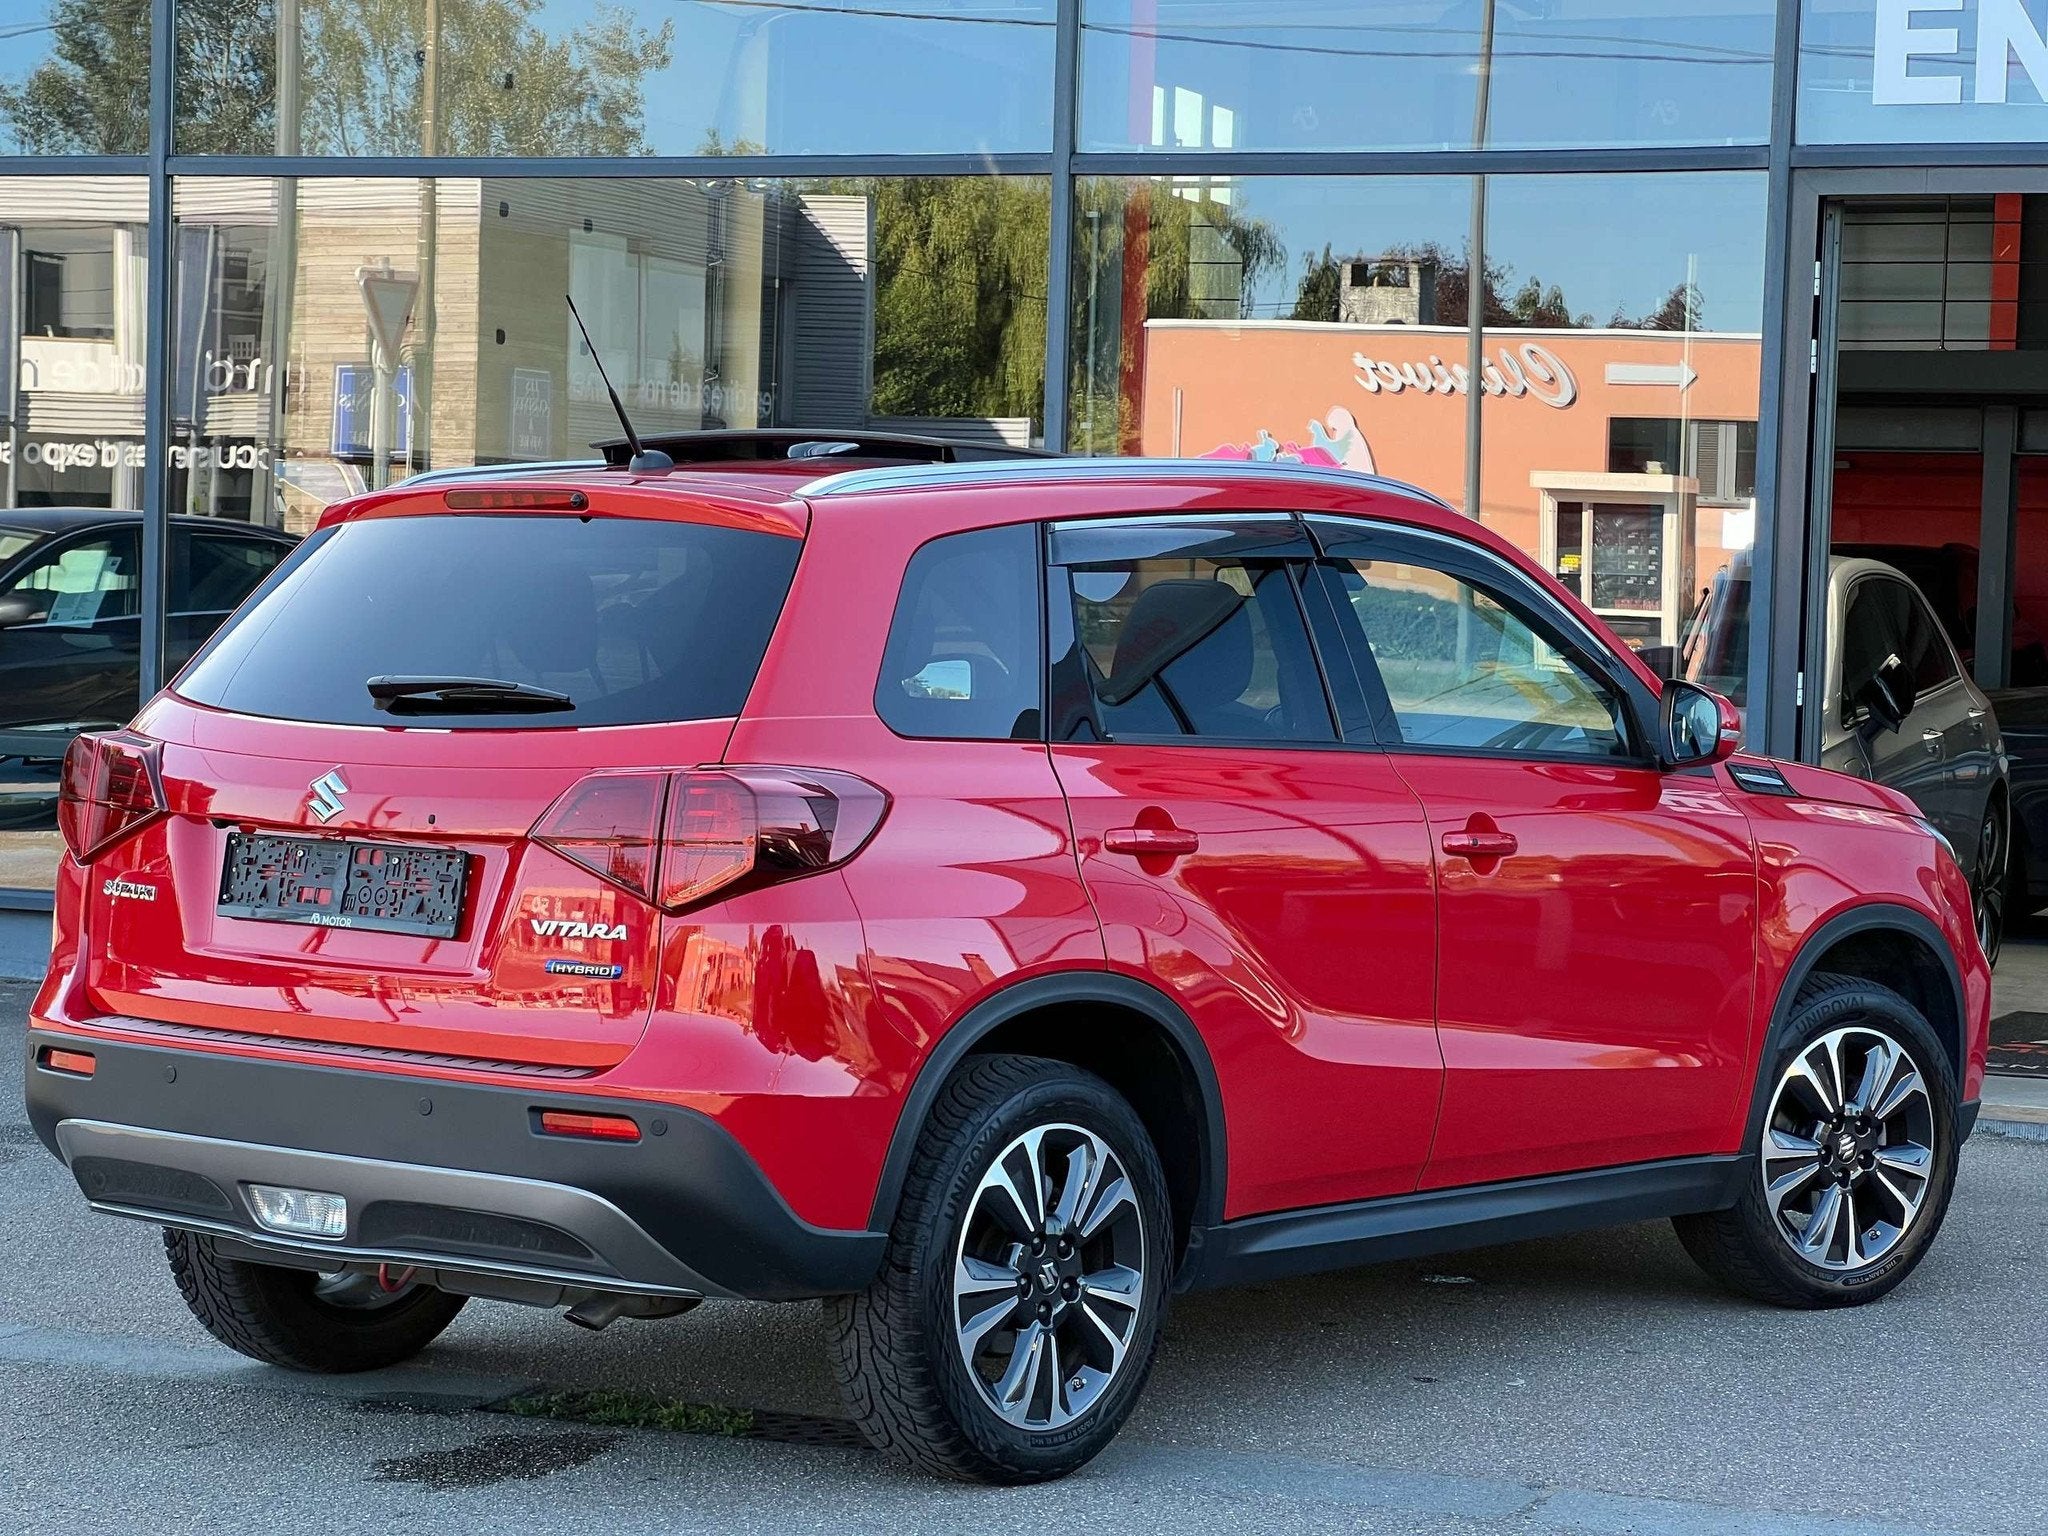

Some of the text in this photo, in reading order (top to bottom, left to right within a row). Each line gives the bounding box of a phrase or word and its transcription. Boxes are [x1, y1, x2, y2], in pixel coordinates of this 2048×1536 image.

[103, 880, 156, 901] SUZUKI
[322, 916, 352, 928] MOTOR
[530, 919, 628, 940] VITARA
[556, 963, 610, 977] HYBRID
